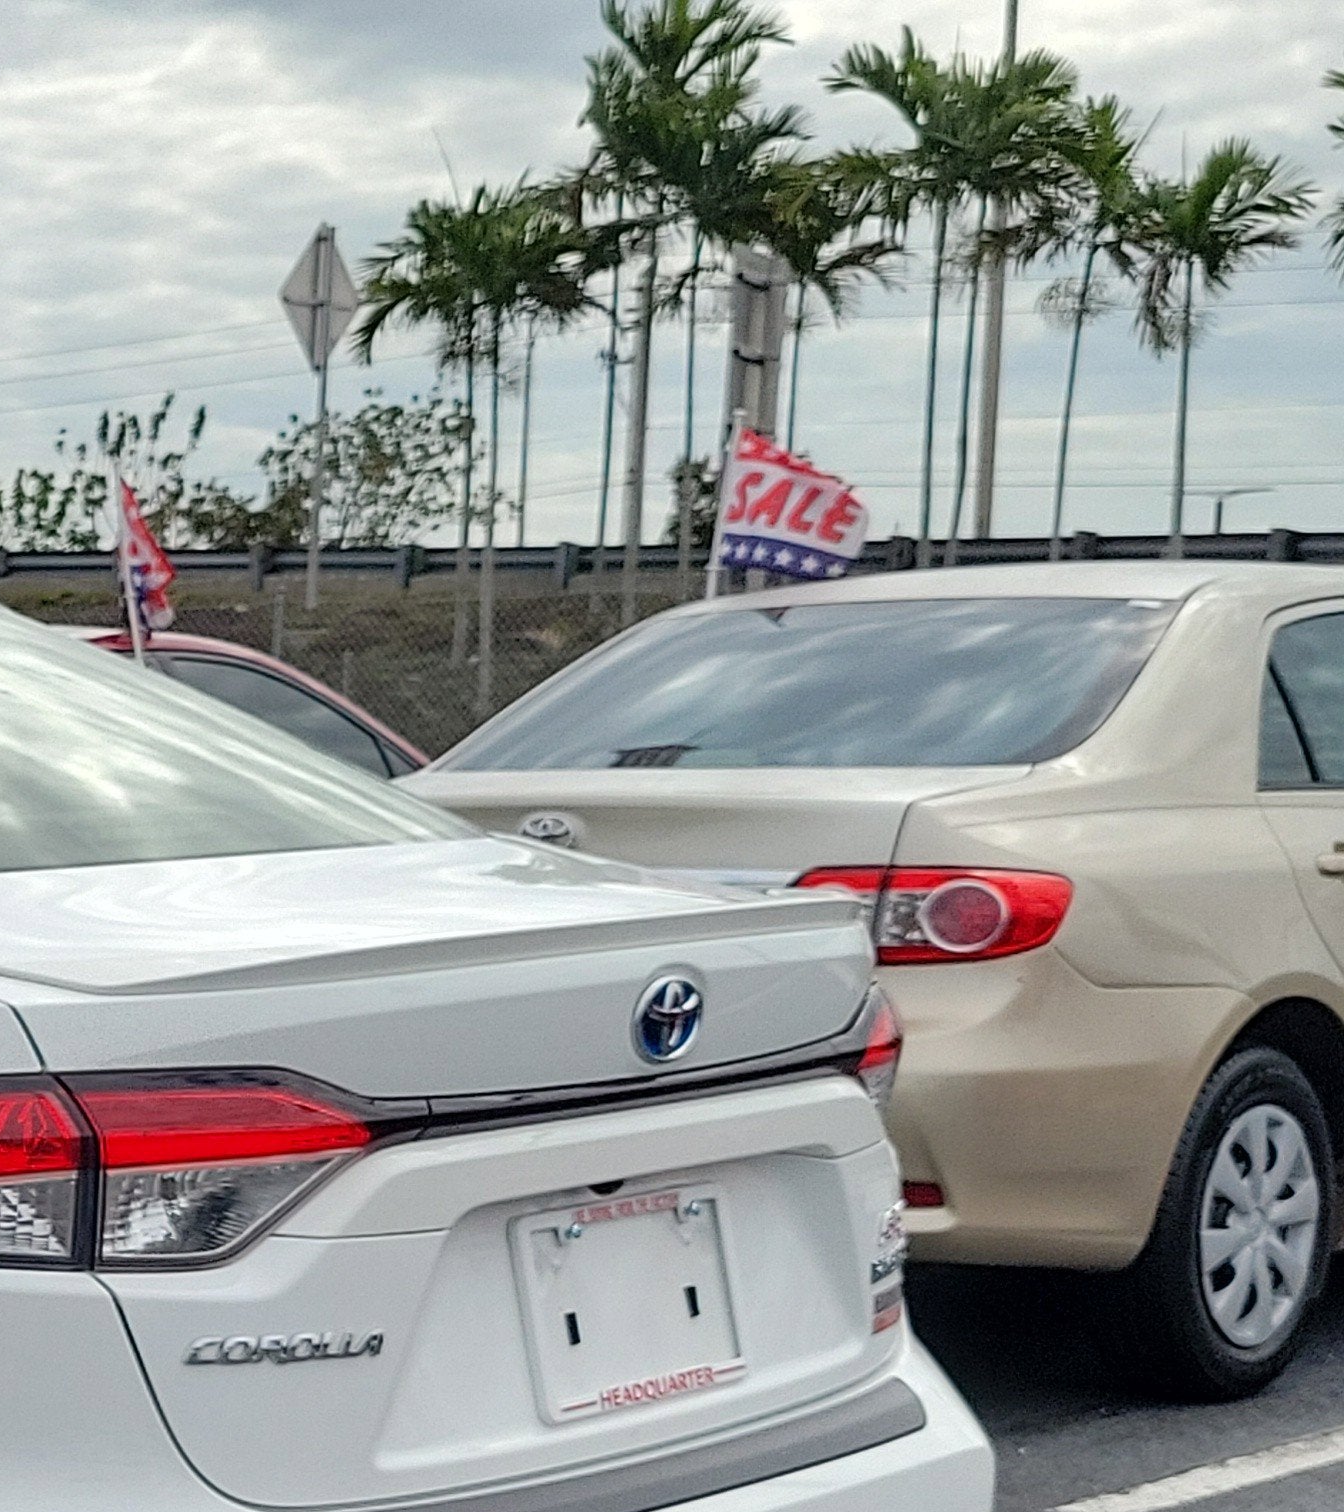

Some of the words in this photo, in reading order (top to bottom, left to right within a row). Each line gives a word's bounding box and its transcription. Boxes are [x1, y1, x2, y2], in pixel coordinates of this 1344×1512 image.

[725, 471, 864, 544] SALE
[183, 1330, 385, 1365] COROLLA
[598, 1366, 714, 1410] HEADQUARTER
